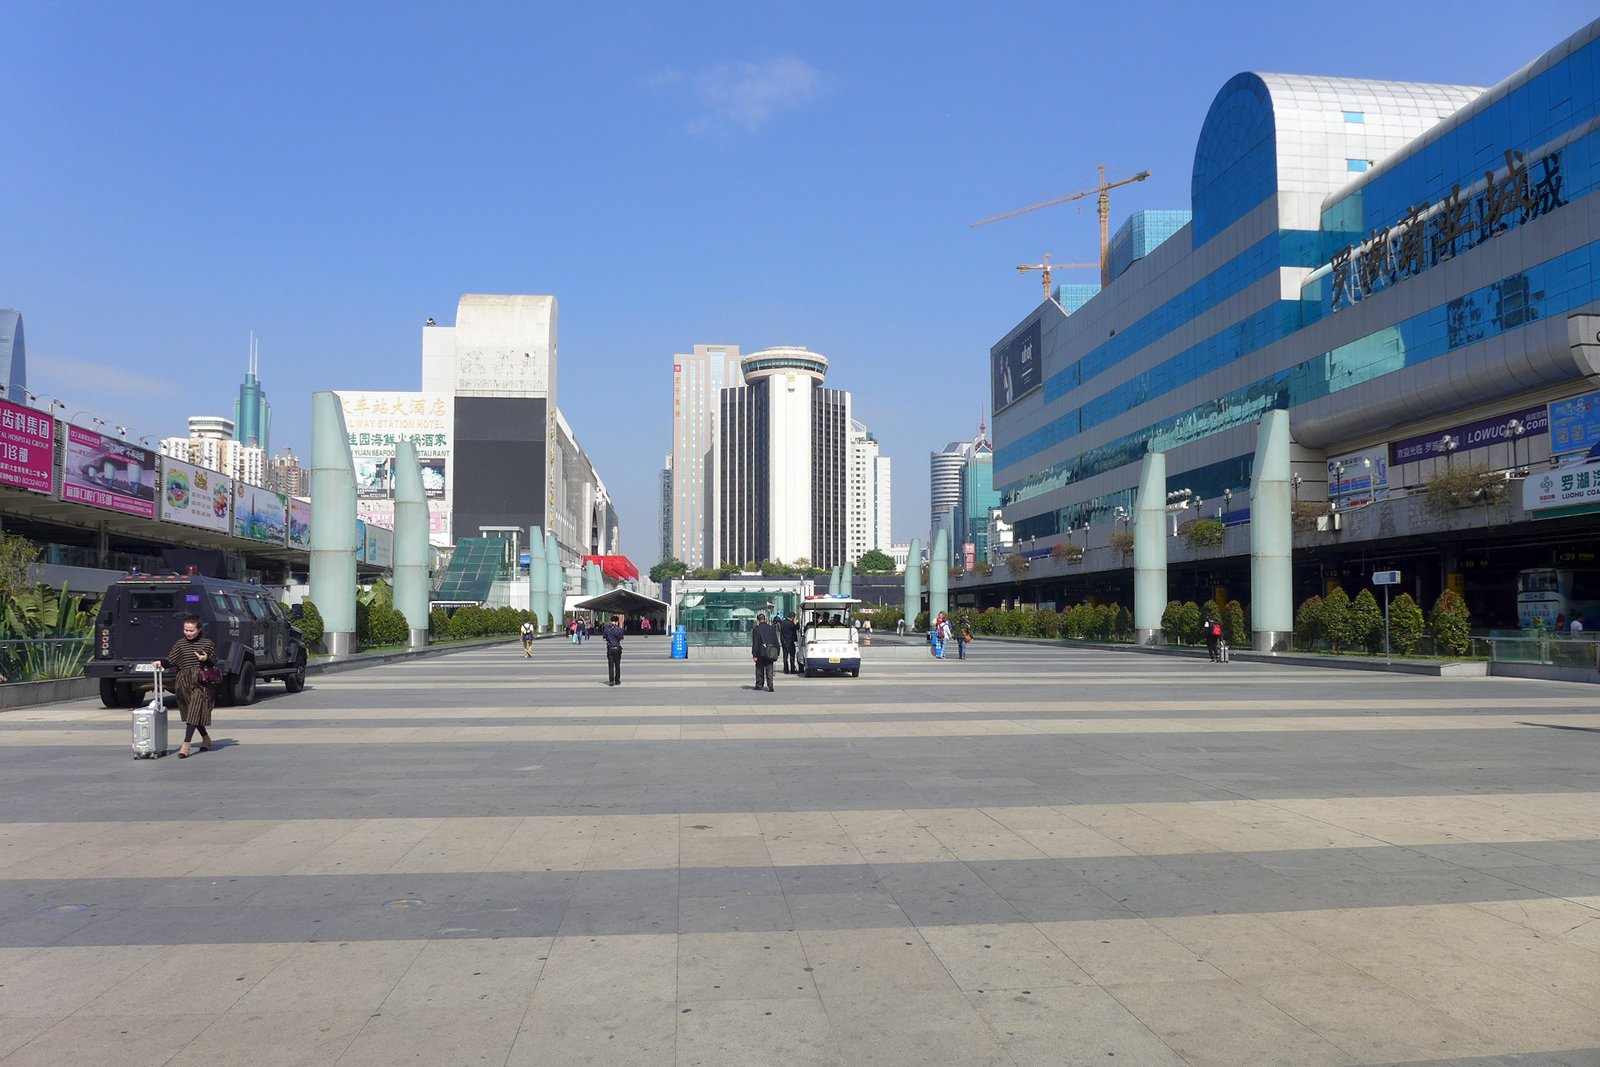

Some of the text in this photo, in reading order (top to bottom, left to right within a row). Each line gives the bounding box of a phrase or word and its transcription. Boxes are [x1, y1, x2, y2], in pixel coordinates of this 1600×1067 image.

[1331, 149, 1536, 308] 罗湖商业城
[0, 408, 49, 439] 齿科集团
[378, 420, 414, 429] STATION
[417, 420, 445, 429] HOTEL
[8, 433, 31, 446] HOSPITAL
[32, 440, 49, 450] GROUP
[372, 449, 396, 457] SEAFOO
[1562, 491, 1584, 499] LUOHU
